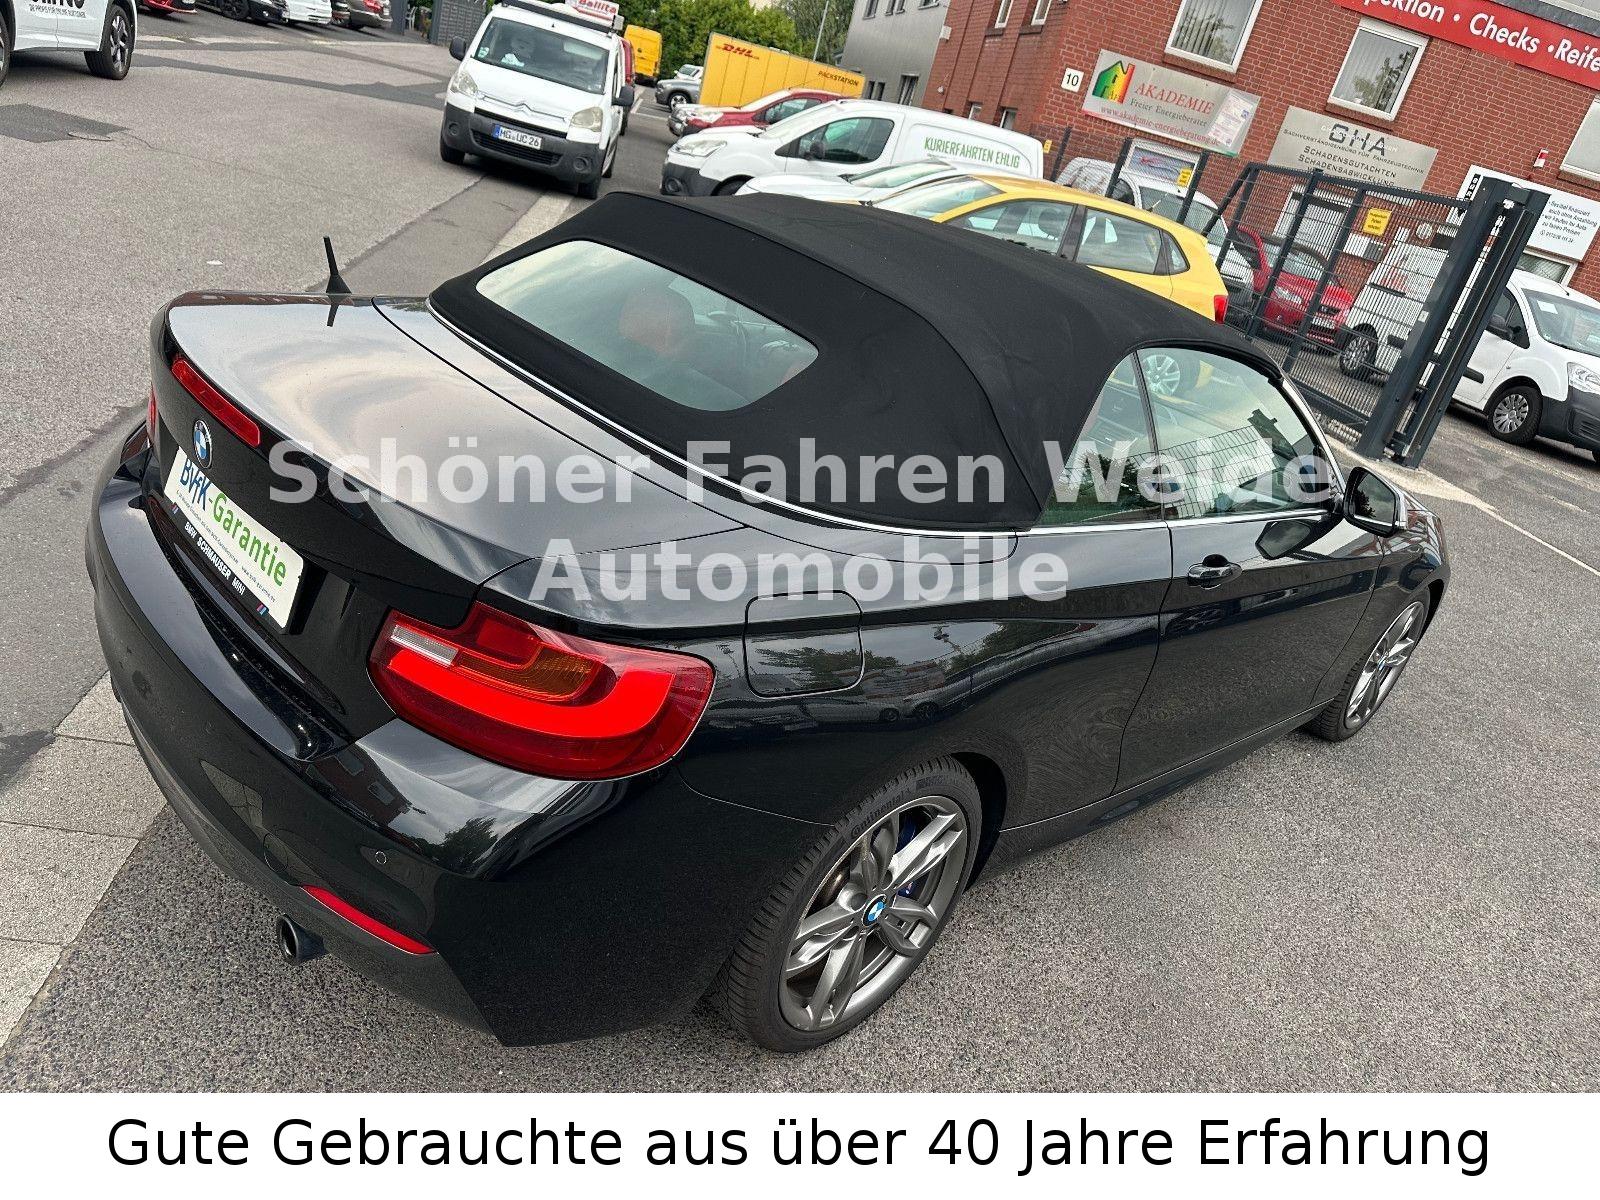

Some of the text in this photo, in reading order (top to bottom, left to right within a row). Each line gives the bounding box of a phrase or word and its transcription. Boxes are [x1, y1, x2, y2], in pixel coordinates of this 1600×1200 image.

[1364, 0, 1446, 23] ktion
[1469, 12, 1541, 54] Checks
[722, 43, 754, 58] DHL
[818, 70, 860, 87] PACKSTATION
[1066, 73, 1080, 87] 10
[1129, 98, 1208, 128] Freier Energieberater
[1135, 83, 1215, 116] AKADEMIE
[528, 136, 540, 147] 26
[924, 137, 1020, 169] KURIERFAHRTEN EHLIG
[1329, 123, 1385, 157] GHA
[1297, 153, 1395, 188] SCHADENSABWICKLUNG
[1303, 145, 1397, 179] SCHADENSGUTACHTEN
[180, 458, 287, 587] BVfK-Garantie
[184, 520, 246, 596] BMW SCHMAUSER MINI
